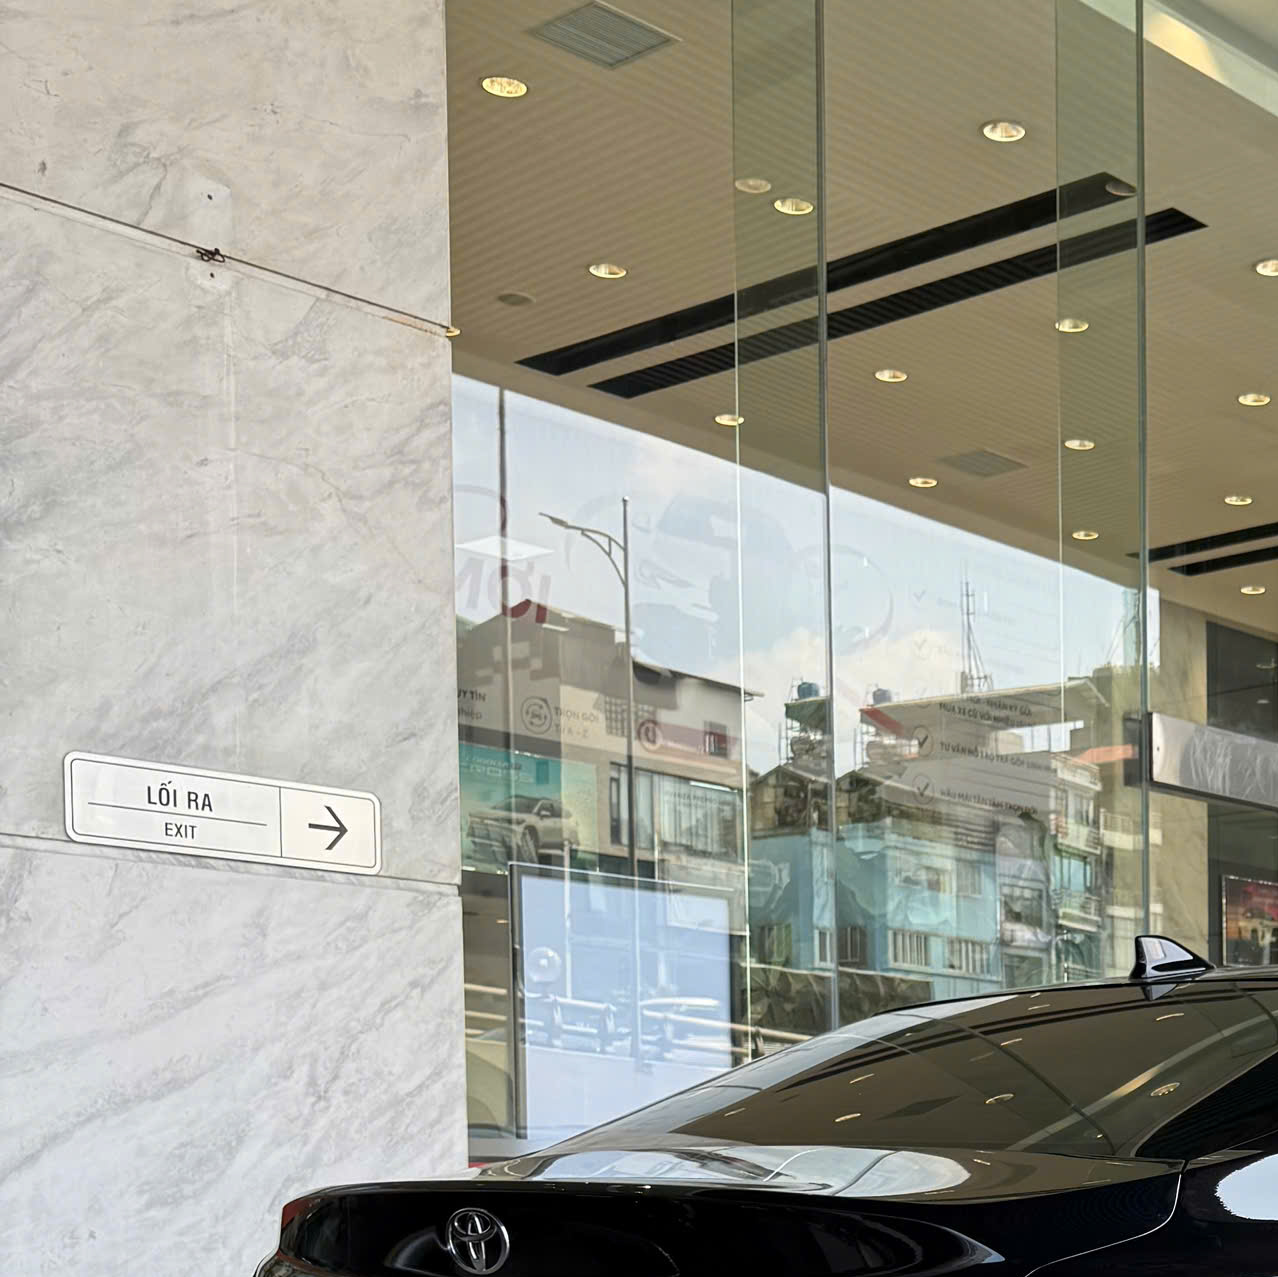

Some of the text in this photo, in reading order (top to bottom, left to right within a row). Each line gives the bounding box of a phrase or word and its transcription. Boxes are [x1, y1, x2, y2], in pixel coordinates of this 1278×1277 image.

[147, 781, 213, 812] LỐI RA
[165, 822, 198, 839] EXIT
